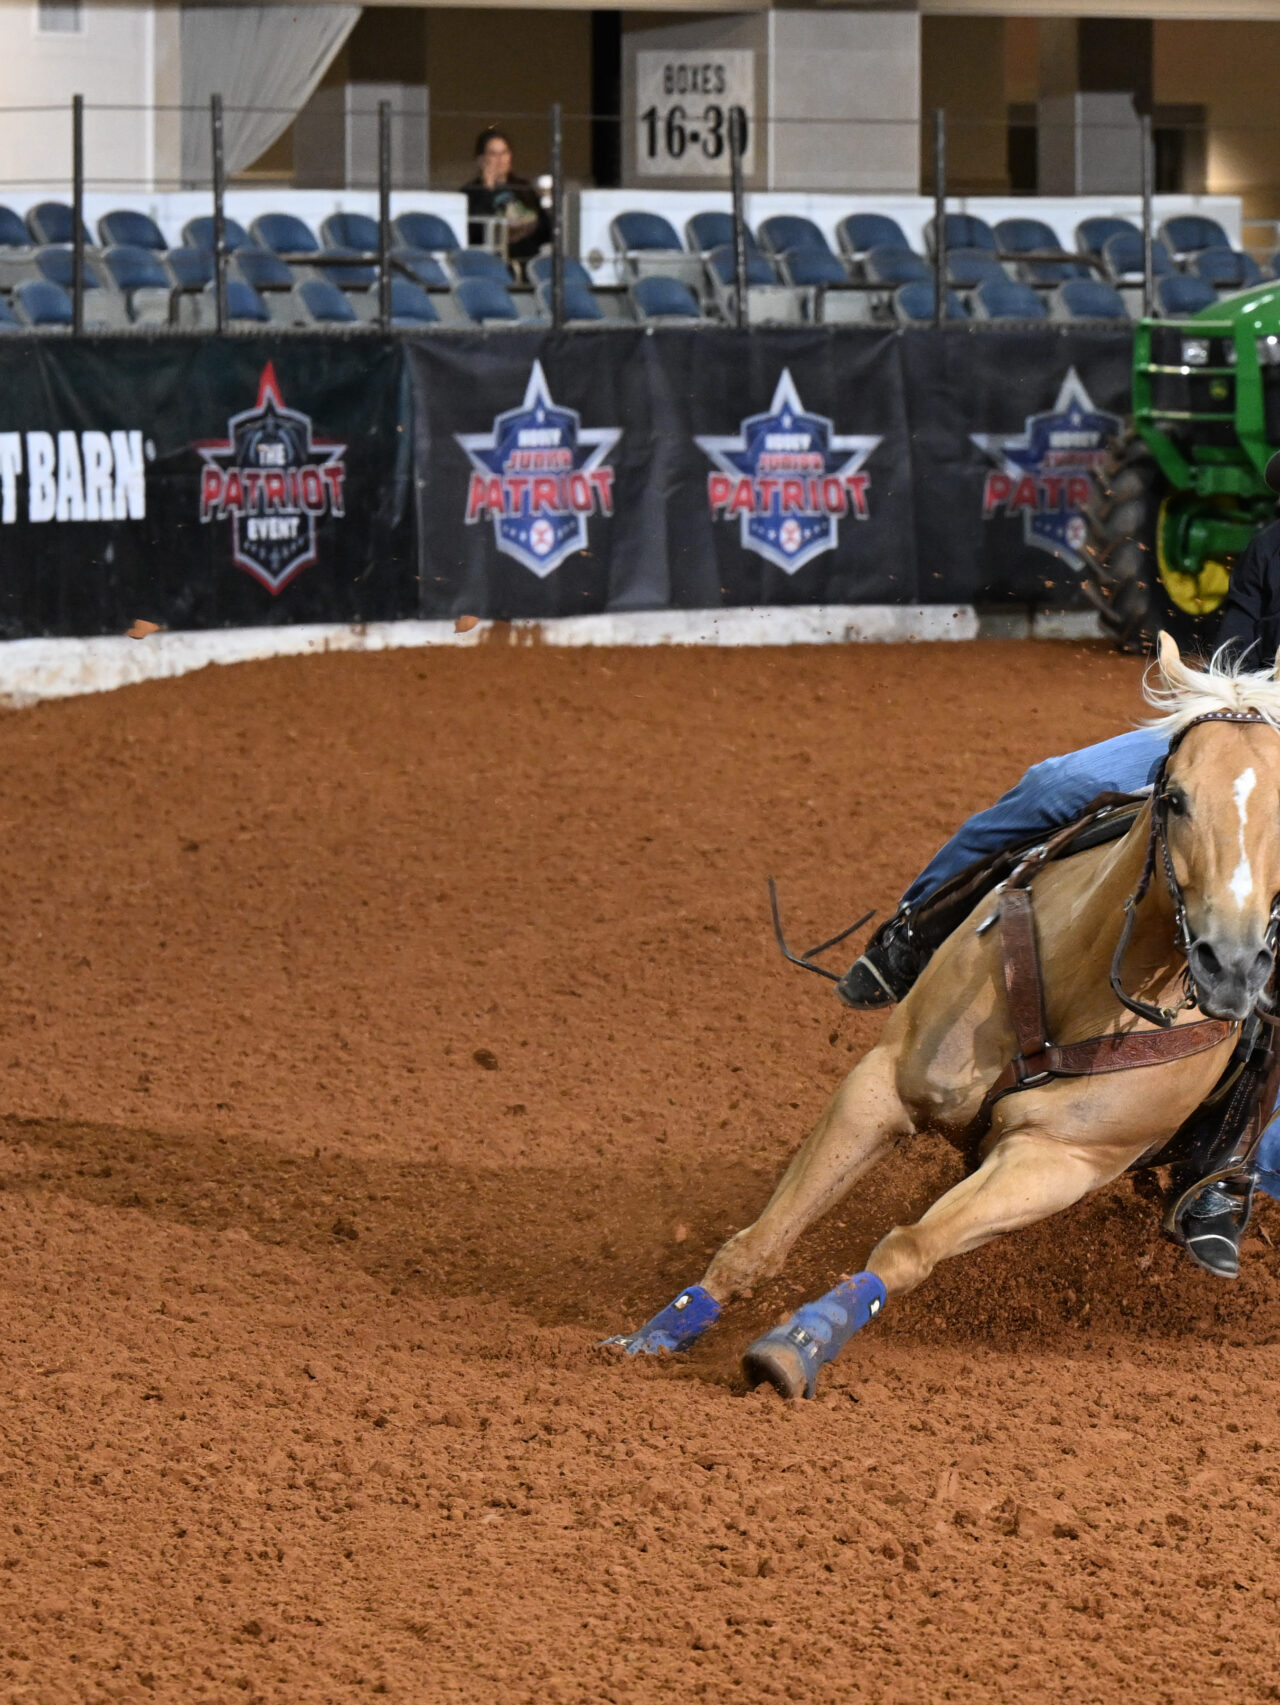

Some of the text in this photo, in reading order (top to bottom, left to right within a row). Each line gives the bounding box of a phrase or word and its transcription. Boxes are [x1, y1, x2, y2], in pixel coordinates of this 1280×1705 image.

[663, 64, 725, 95] BOXES
[26, 430, 146, 523] BARN
[257, 442, 286, 466] THE
[200, 461, 346, 524] PATRIOT
[464, 465, 616, 526] PATRIOT
[707, 470, 872, 522] PATRIOT
[982, 469, 1092, 520] PATR
[247, 516, 300, 542] EVENT
